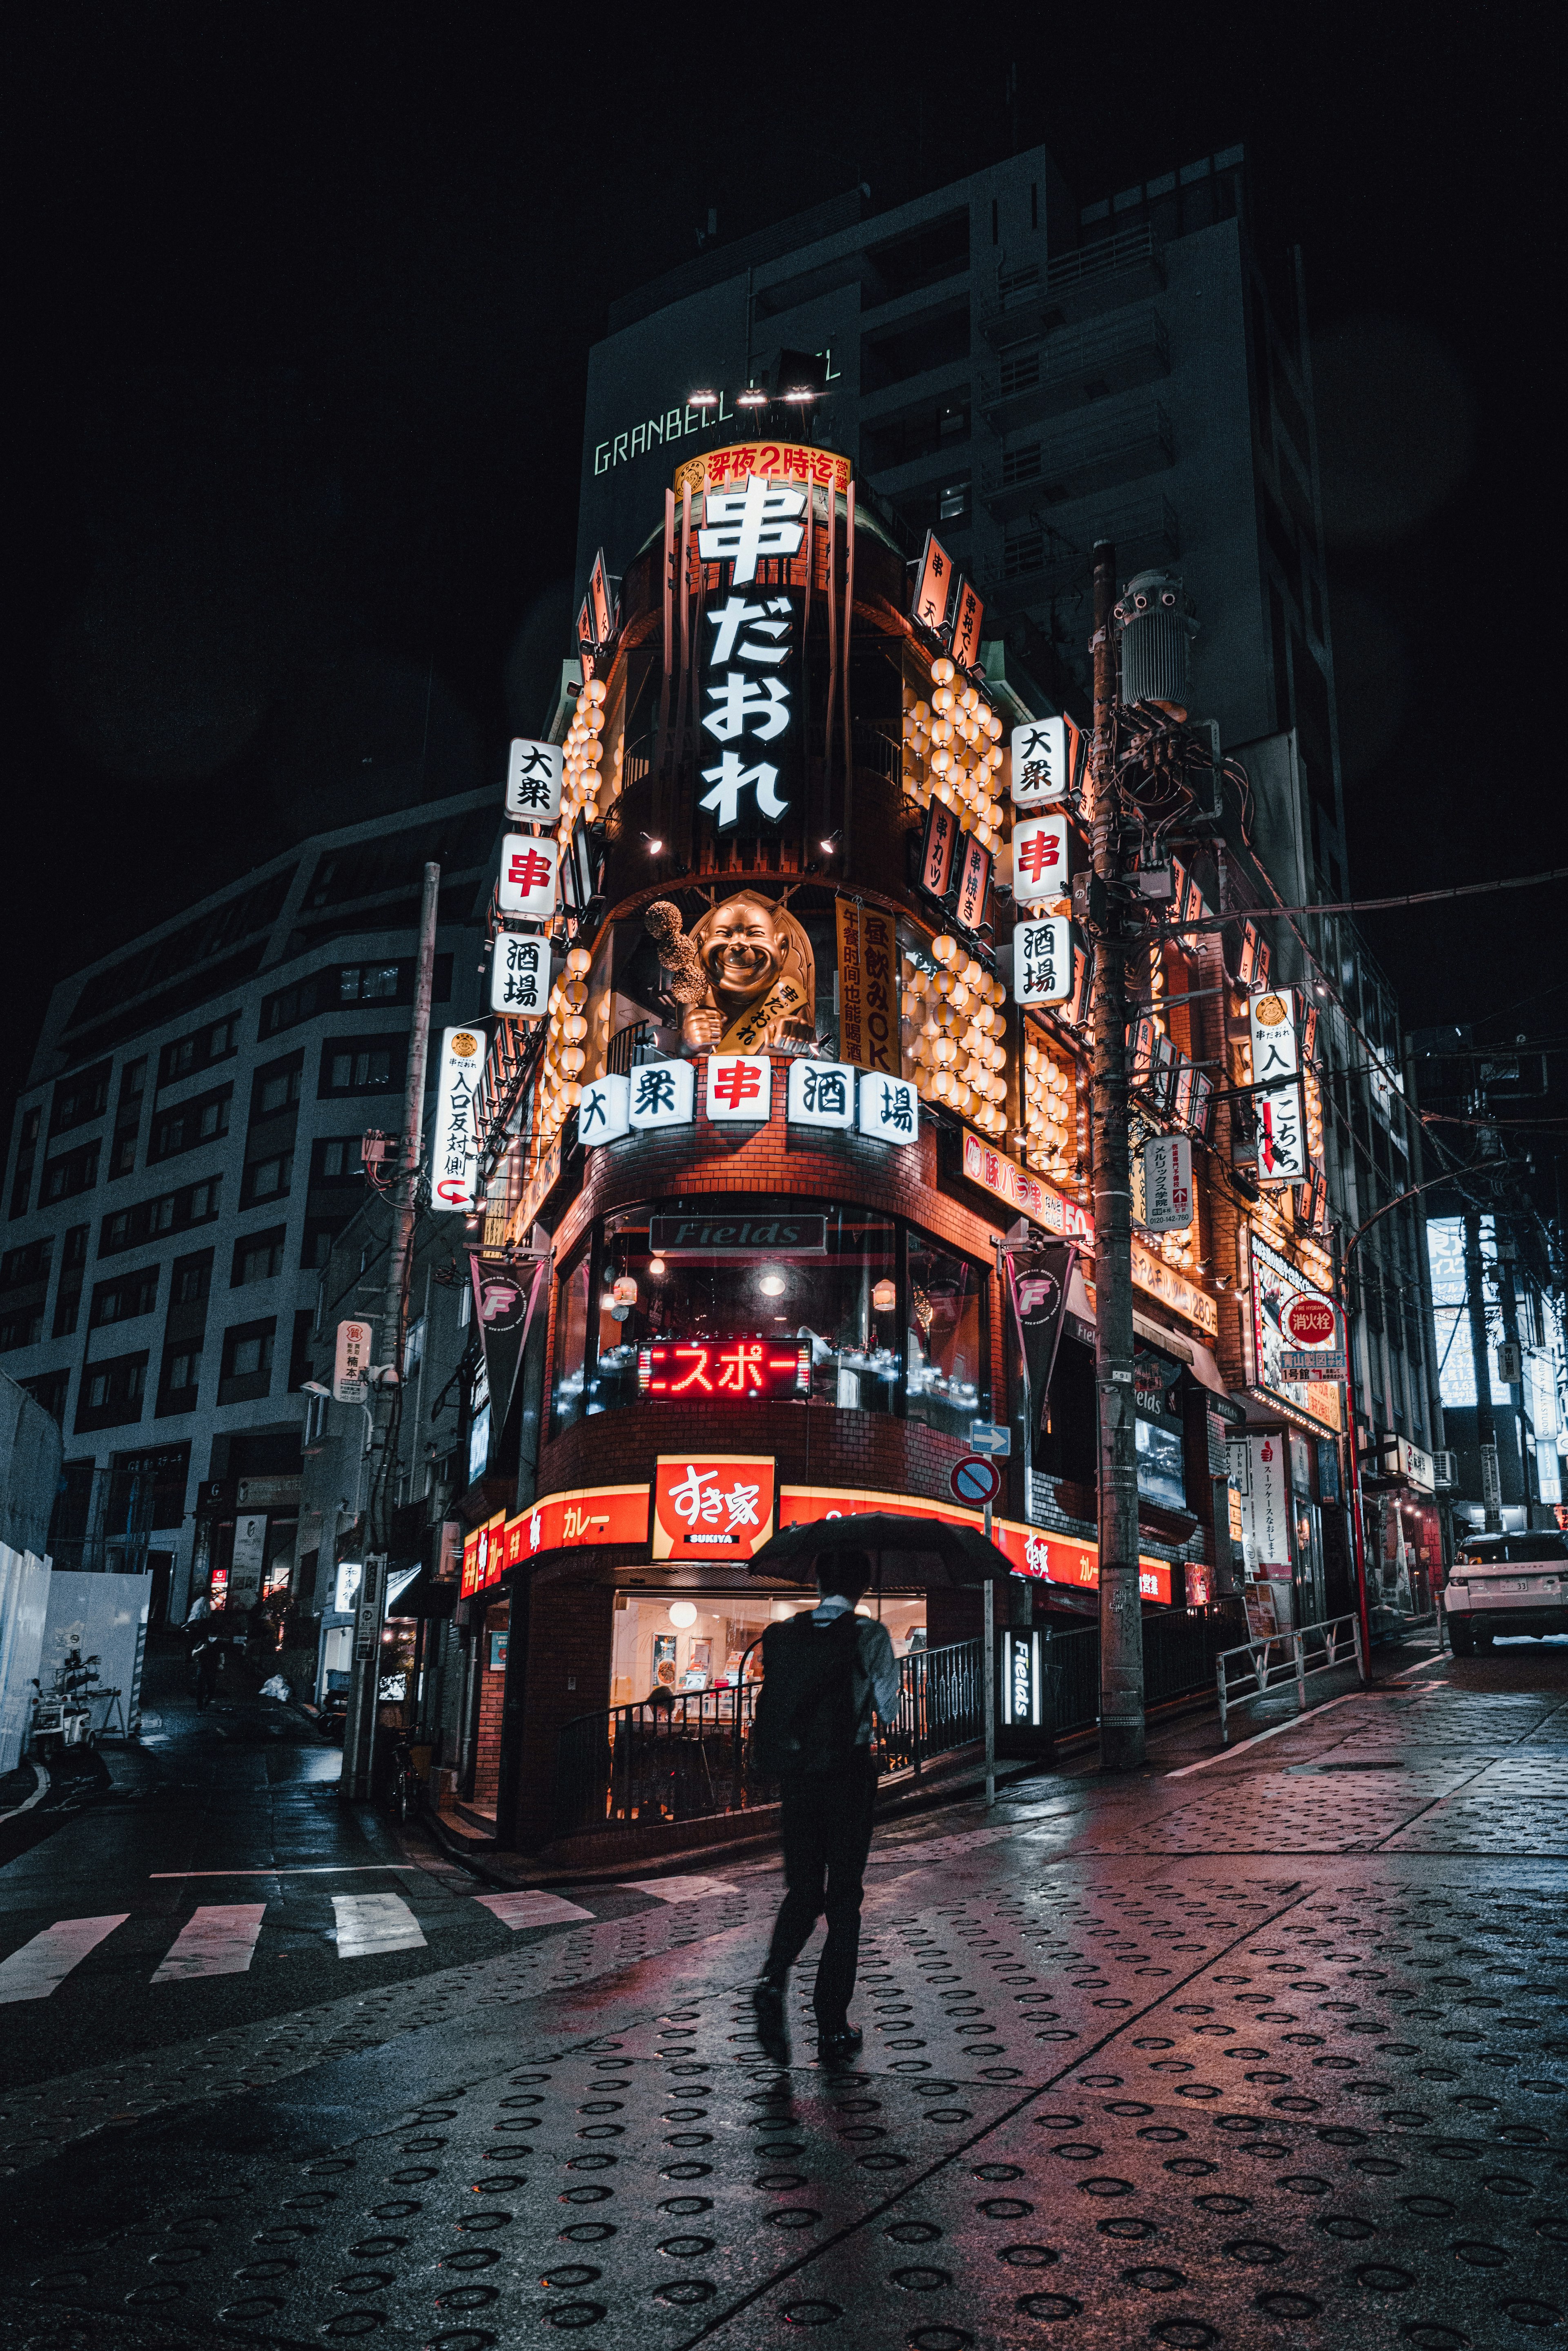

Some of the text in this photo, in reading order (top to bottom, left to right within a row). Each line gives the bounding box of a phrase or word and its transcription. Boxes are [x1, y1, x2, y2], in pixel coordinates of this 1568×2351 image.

[595, 391, 733, 475] GRANBELL
[707, 446, 834, 483] 深夜2時迄
[835, 459, 848, 490] 営業
[697, 474, 807, 829] 串だおれ
[517, 746, 553, 809] 大衆
[1021, 729, 1052, 791] 大衆
[508, 848, 552, 897] 串
[930, 814, 948, 887] 串カツ
[1019, 830, 1060, 883] 串
[963, 849, 980, 923] 串焼き
[504, 939, 540, 1007] 酒場
[1023, 924, 1056, 994] 酒場
[736, 983, 799, 1046] 串だおれ
[864, 916, 891, 1073] 昼飲みOK
[1256, 1030, 1290, 1041] 串だおれ
[450, 1058, 477, 1068] 串だおれ
[444, 1071, 473, 1177] 入口反対側
[984, 1147, 1043, 1218] 豚バラ串
[1154, 1145, 1168, 1207] メルリックス学院
[674, 1222, 801, 1244] Fields
[1150, 1214, 1189, 1224] 0120-142-760
[350, 1328, 360, 1339] 質
[1078, 1324, 1096, 1344] Fiel
[1292, 1312, 1331, 1330] 消火栓
[345, 1356, 359, 1379] 楠本
[1283, 1353, 1327, 1367] 青山製図
[1283, 1368, 1310, 1380] 1号館
[1135, 1389, 1161, 1414] elds
[562, 1506, 610, 1539] カレー
[668, 1464, 760, 1533] すき家
[1264, 1466, 1274, 1558] スーツケースなおします
[690, 1533, 733, 1544] SUKIYA
[1024, 1528, 1049, 1578] すき家
[1139, 1573, 1159, 1595] 営業
[1015, 1640, 1029, 1716] Fields
